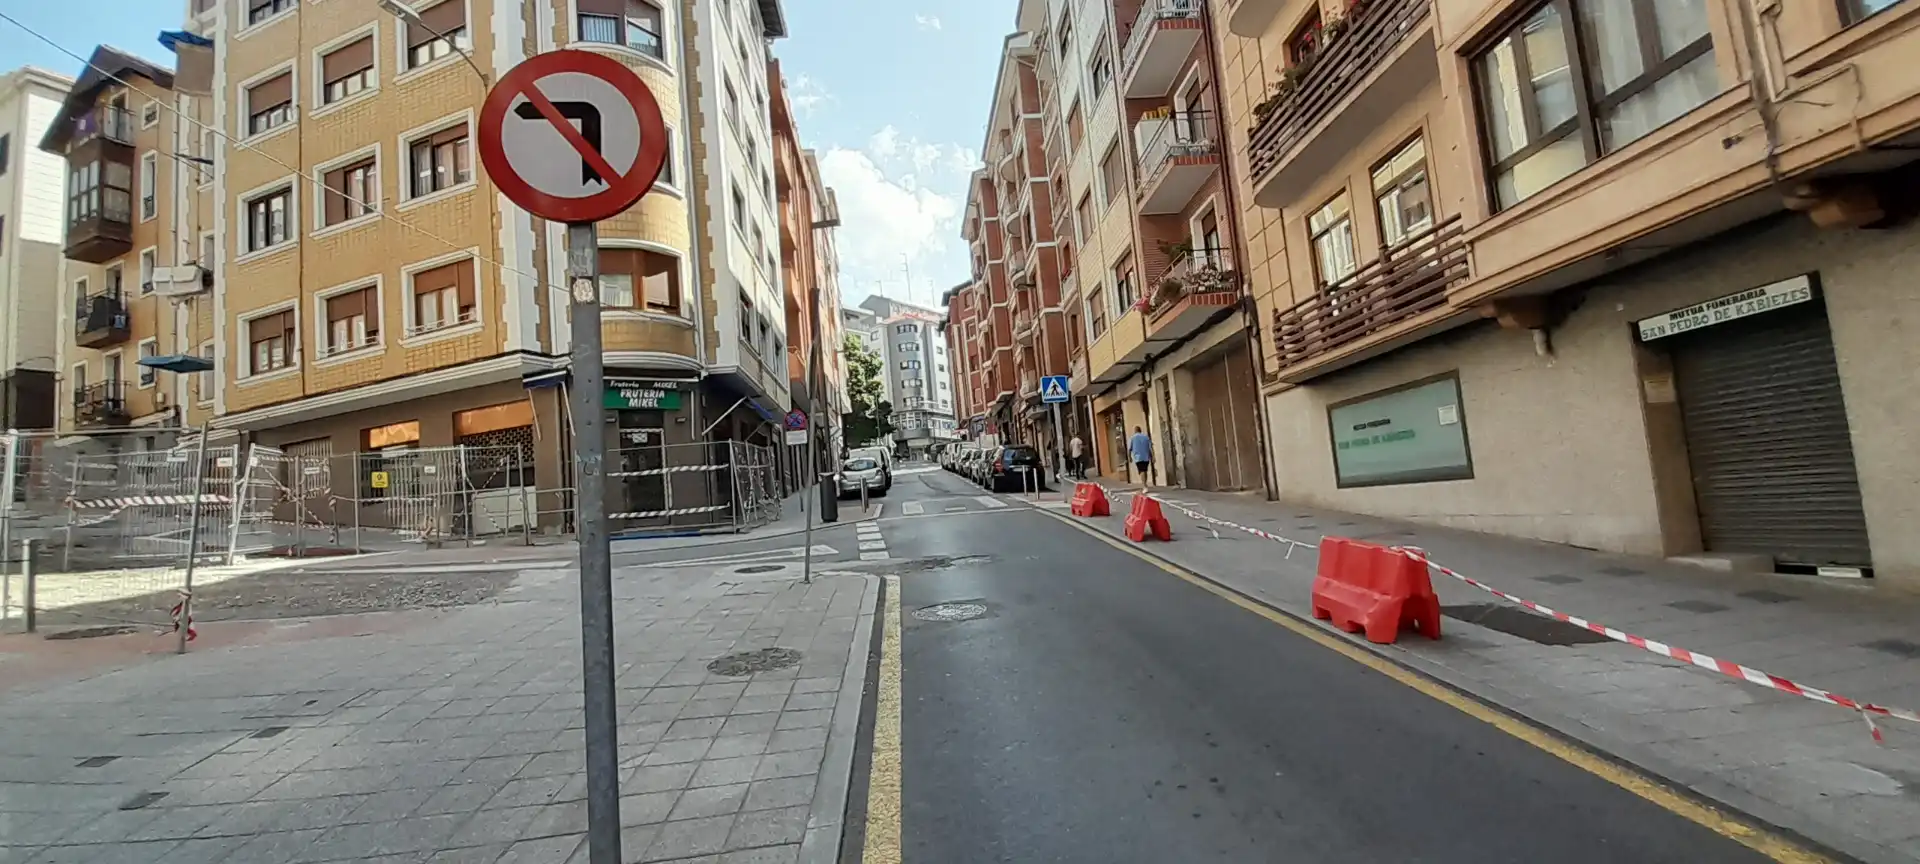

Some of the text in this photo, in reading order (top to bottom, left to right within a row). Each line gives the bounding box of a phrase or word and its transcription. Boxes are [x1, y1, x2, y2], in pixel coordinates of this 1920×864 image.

[1641, 287, 1809, 340] SAN PEDRO DE KABIEZES
[1669, 289, 1767, 321] MUTUA FUNERARIA
[620, 389, 665, 399] FRUTERIA
[628, 398, 659, 408] MIKEL
